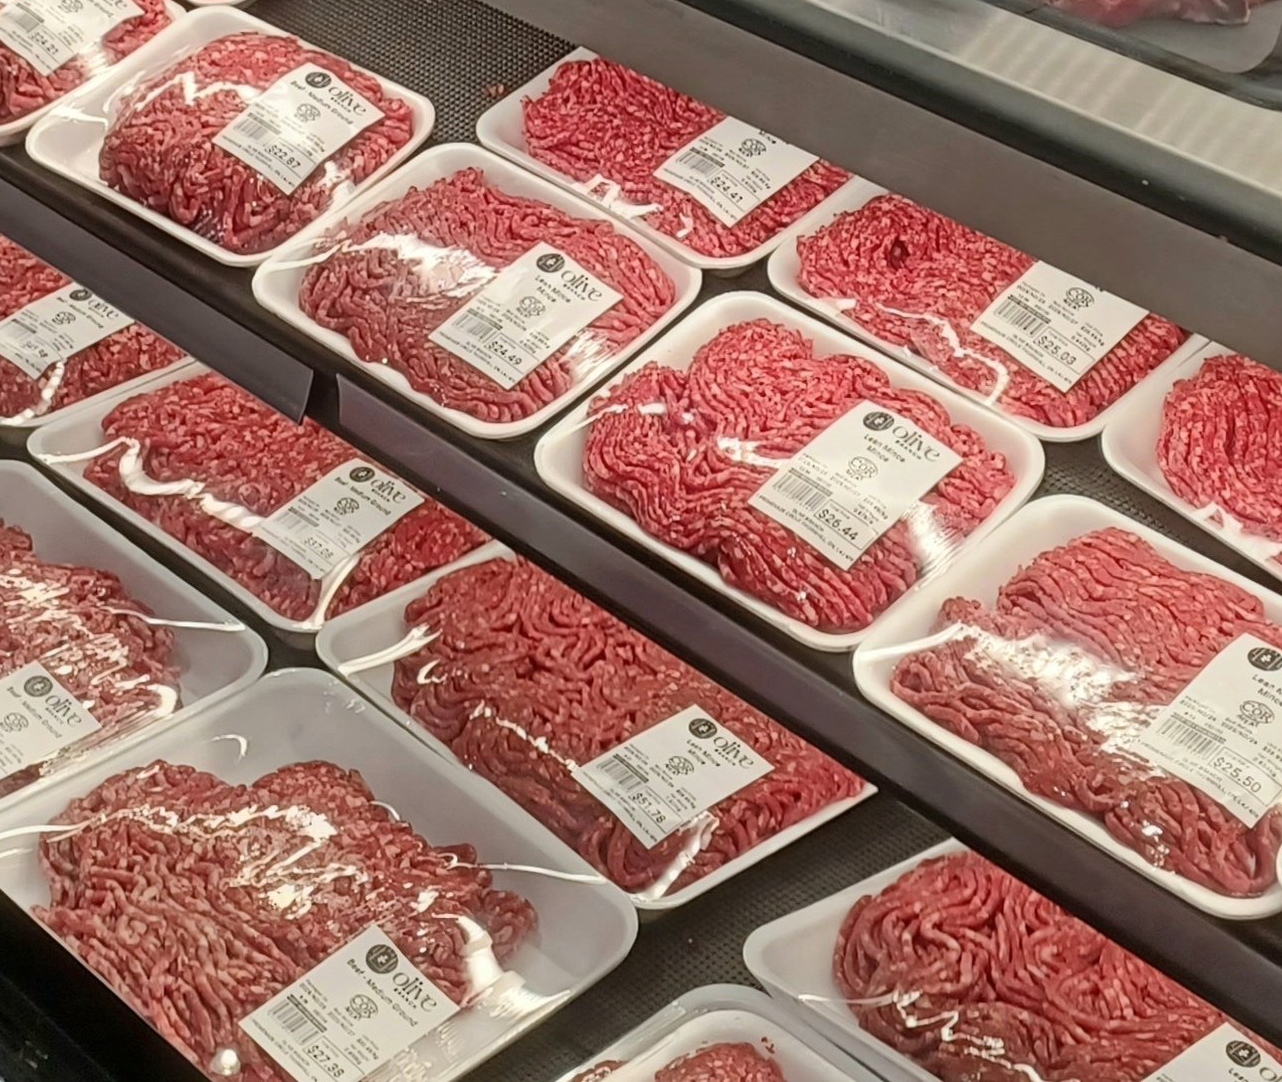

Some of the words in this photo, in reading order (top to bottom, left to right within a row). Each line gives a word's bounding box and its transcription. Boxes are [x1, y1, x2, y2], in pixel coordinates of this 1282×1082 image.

[327, 86, 366, 112] olive
[265, 144, 301, 168] $22.87
[560, 270, 602, 300] olive
[487, 340, 522, 365] $24.49
[1034, 335, 1077, 365] $25.03
[863, 433, 883, 447] Lean
[882, 444, 906, 463] Mince
[866, 444, 889, 462] Mince
[891, 425, 940, 459] olive
[370, 479, 406, 502] olive
[818, 508, 858, 540] $26.44
[1251, 673, 1275, 689] Lean
[44, 694, 82, 724] olive
[712, 736, 754, 766] olive
[1213, 756, 1261, 793] $25.50
[631, 792, 666, 824] $51.78
[346, 958, 365, 974] Beef
[365, 978, 393, 1004] Medium
[391, 1002, 418, 1027] Ground
[392, 971, 437, 1009] olive
[307, 1044, 345, 1079] $27.38
